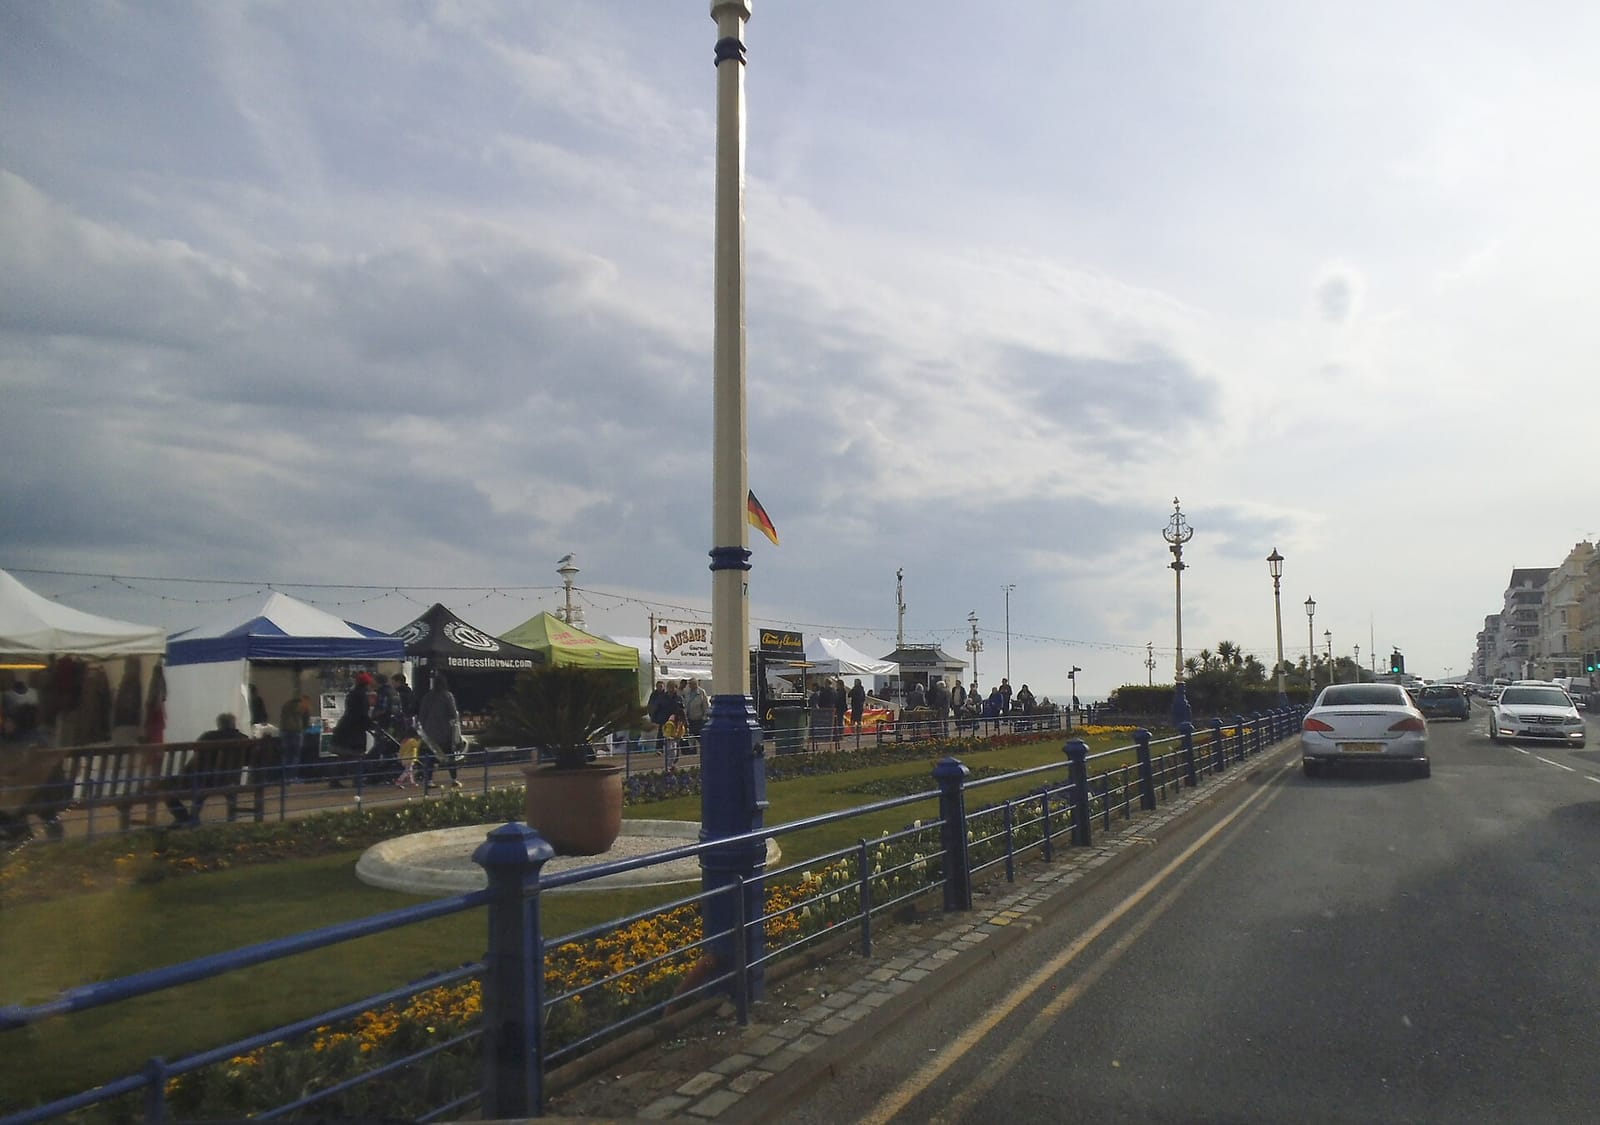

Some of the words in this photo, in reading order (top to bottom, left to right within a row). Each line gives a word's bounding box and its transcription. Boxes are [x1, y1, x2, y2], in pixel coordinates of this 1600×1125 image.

[743, 582, 748, 596] 7
[663, 628, 707, 655] SAUSAGE
[448, 656, 533, 669] fearlessflavour.com
